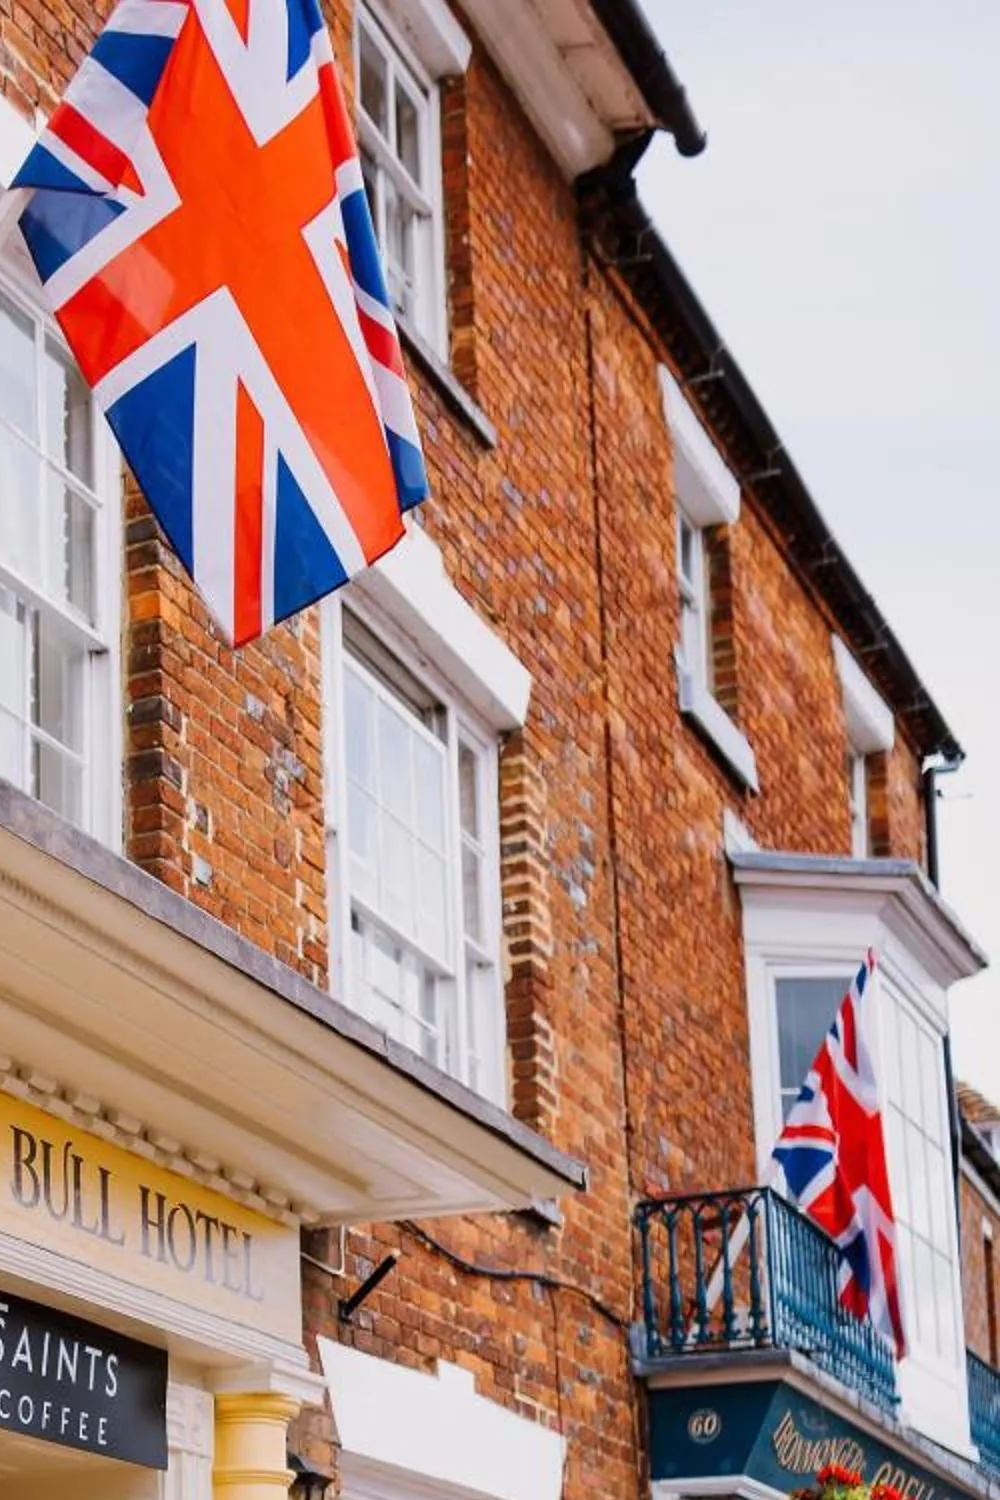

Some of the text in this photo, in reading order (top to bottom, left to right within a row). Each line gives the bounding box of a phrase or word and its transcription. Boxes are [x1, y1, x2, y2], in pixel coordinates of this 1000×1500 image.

[9, 1123, 125, 1248] BULL
[138, 1183, 265, 1301] HOTEL
[688, 1413, 717, 1436] 60
